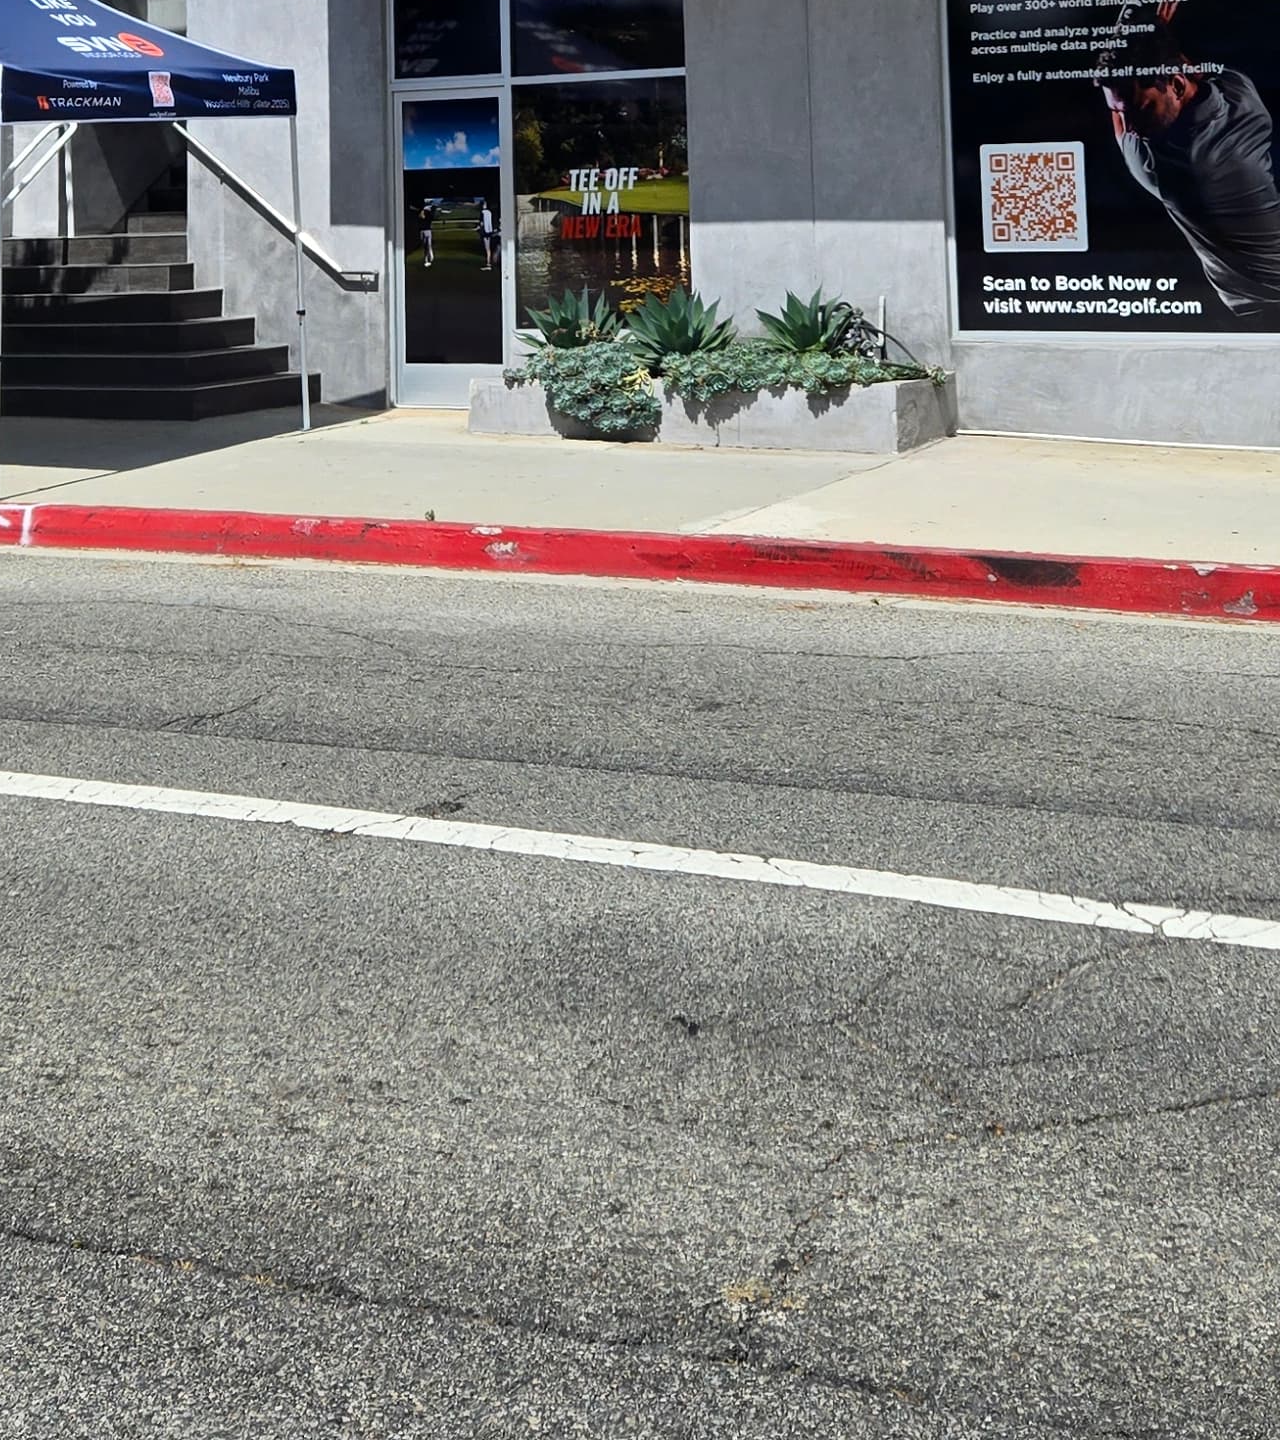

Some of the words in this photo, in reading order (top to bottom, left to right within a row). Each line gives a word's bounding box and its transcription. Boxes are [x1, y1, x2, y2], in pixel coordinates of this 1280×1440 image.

[970, 2, 994, 15] Play
[996, 2, 1022, 12] over
[1024, 0, 1056, 10] 300+
[49, 14, 97, 27] YOU
[971, 29, 1017, 41] Practice
[1019, 27, 1042, 38] and
[1044, 26, 1089, 38] analyze
[1091, 25, 1118, 37] your
[1121, 23, 1155, 35] game
[971, 45, 1008, 55] across
[1010, 41, 1058, 53] multiple
[1060, 40, 1088, 51] data
[1090, 38, 1128, 51] points
[972, 71, 1005, 84] Enjoy
[1007, 72, 1015, 81] a
[1017, 69, 1042, 82] fully
[1045, 67, 1109, 80] automated
[1111, 65, 1133, 77] self
[1136, 64, 1180, 76] service
[1182, 62, 1224, 74] facility
[49, 96, 122, 107] TRACKMAN
[569, 168, 600, 192] TEE
[604, 167, 640, 190] OFF
[581, 192, 603, 215] IN
[607, 191, 620, 215] A
[561, 217, 601, 240] NEW
[605, 215, 643, 238] ERA
[983, 275, 1026, 292] Scan
[1031, 276, 1050, 292] to
[1055, 274, 1104, 292] Book
[1109, 275, 1152, 292] Now
[1156, 278, 1178, 292] or
[983, 297, 1022, 314] visit
[1026, 297, 1202, 317] www.svn2golf.com
